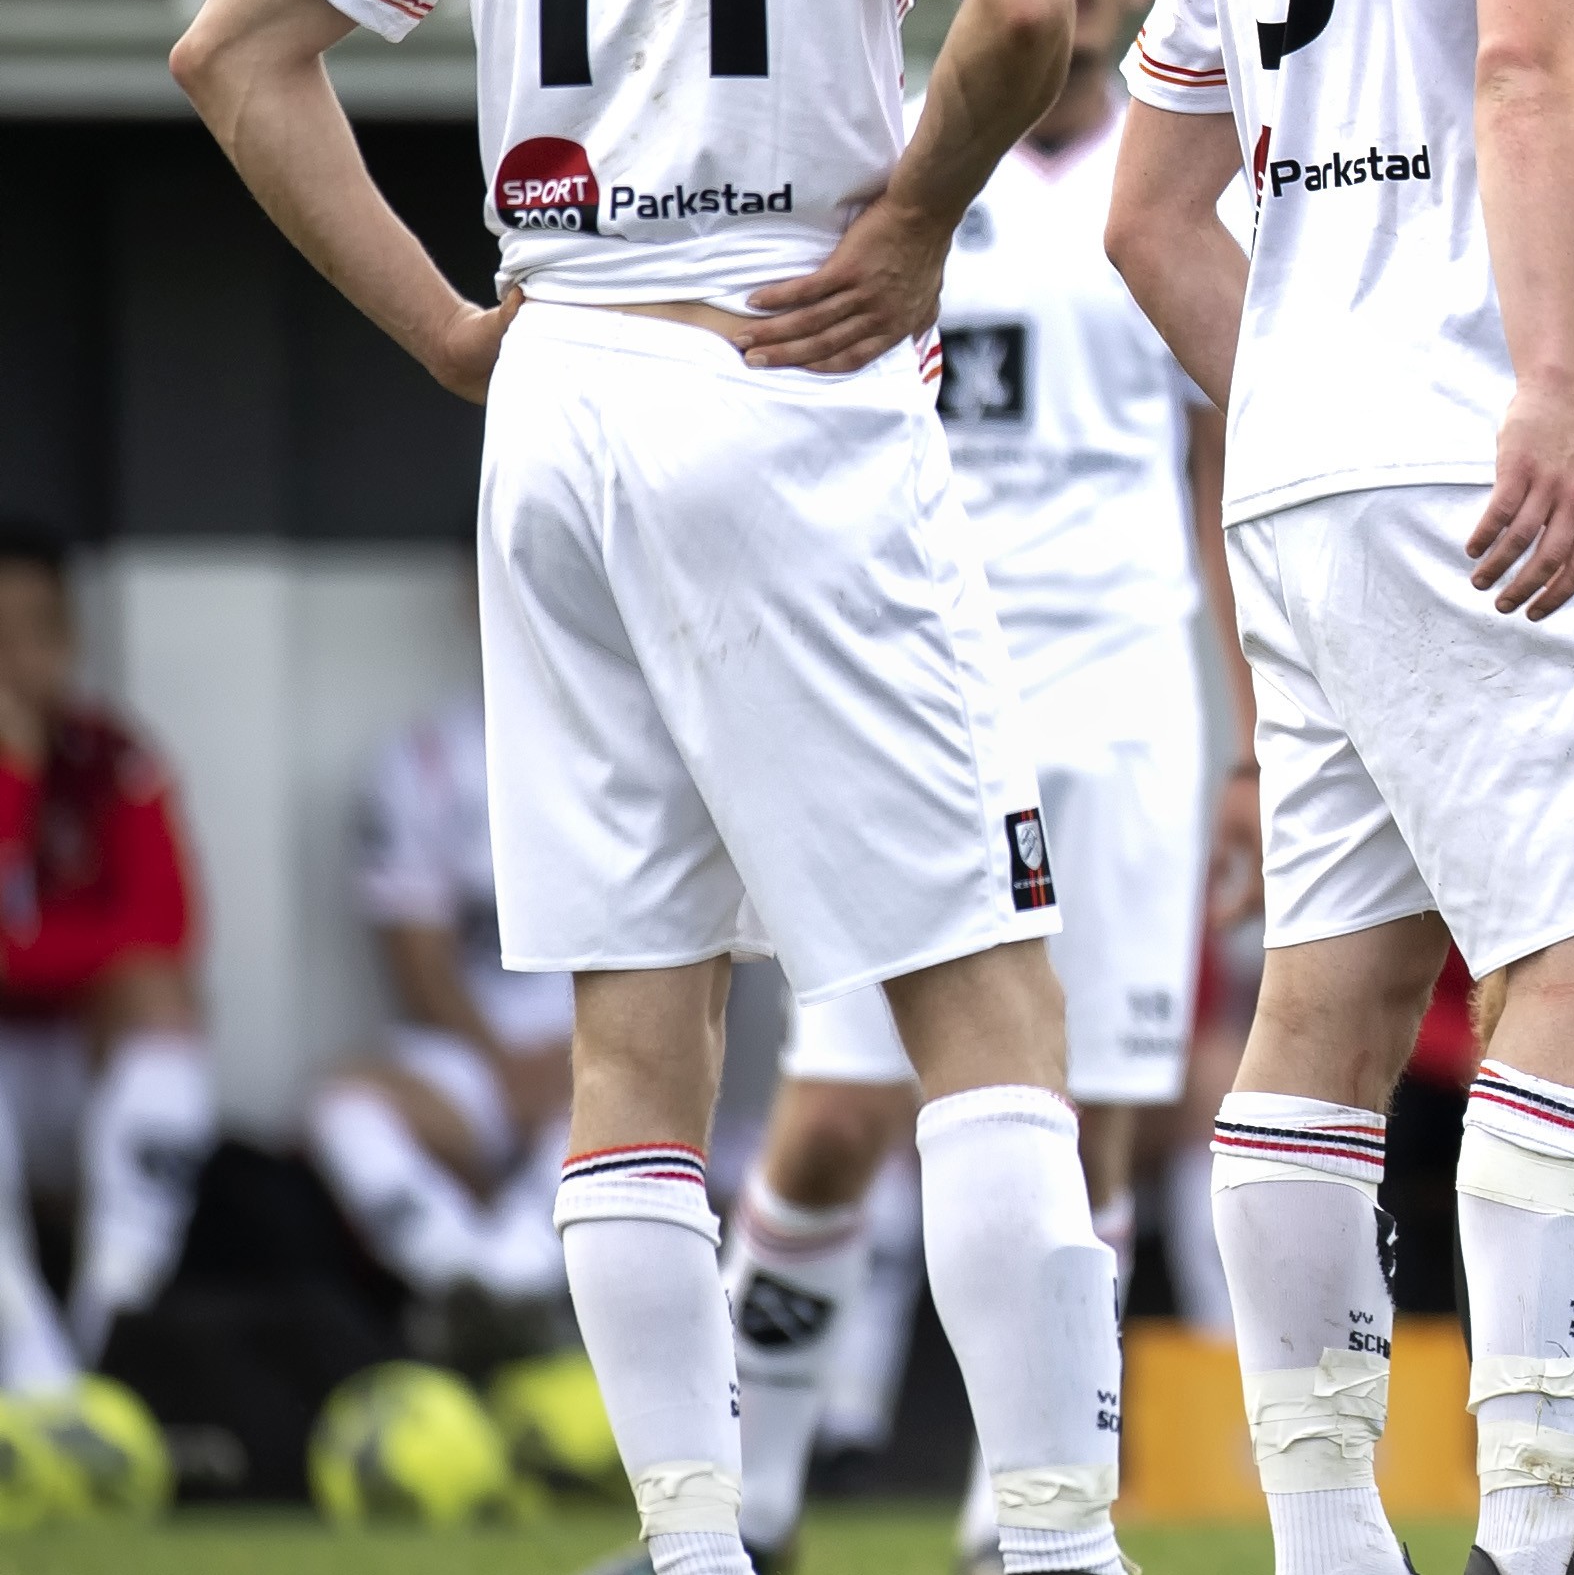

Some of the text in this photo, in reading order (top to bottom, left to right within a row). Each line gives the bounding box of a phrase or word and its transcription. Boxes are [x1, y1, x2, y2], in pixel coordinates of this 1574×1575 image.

[1269, 144, 1432, 198] Parkstad
[502, 175, 794, 221] SPORT Parkstad
[1347, 1330, 1392, 1360] SCH
